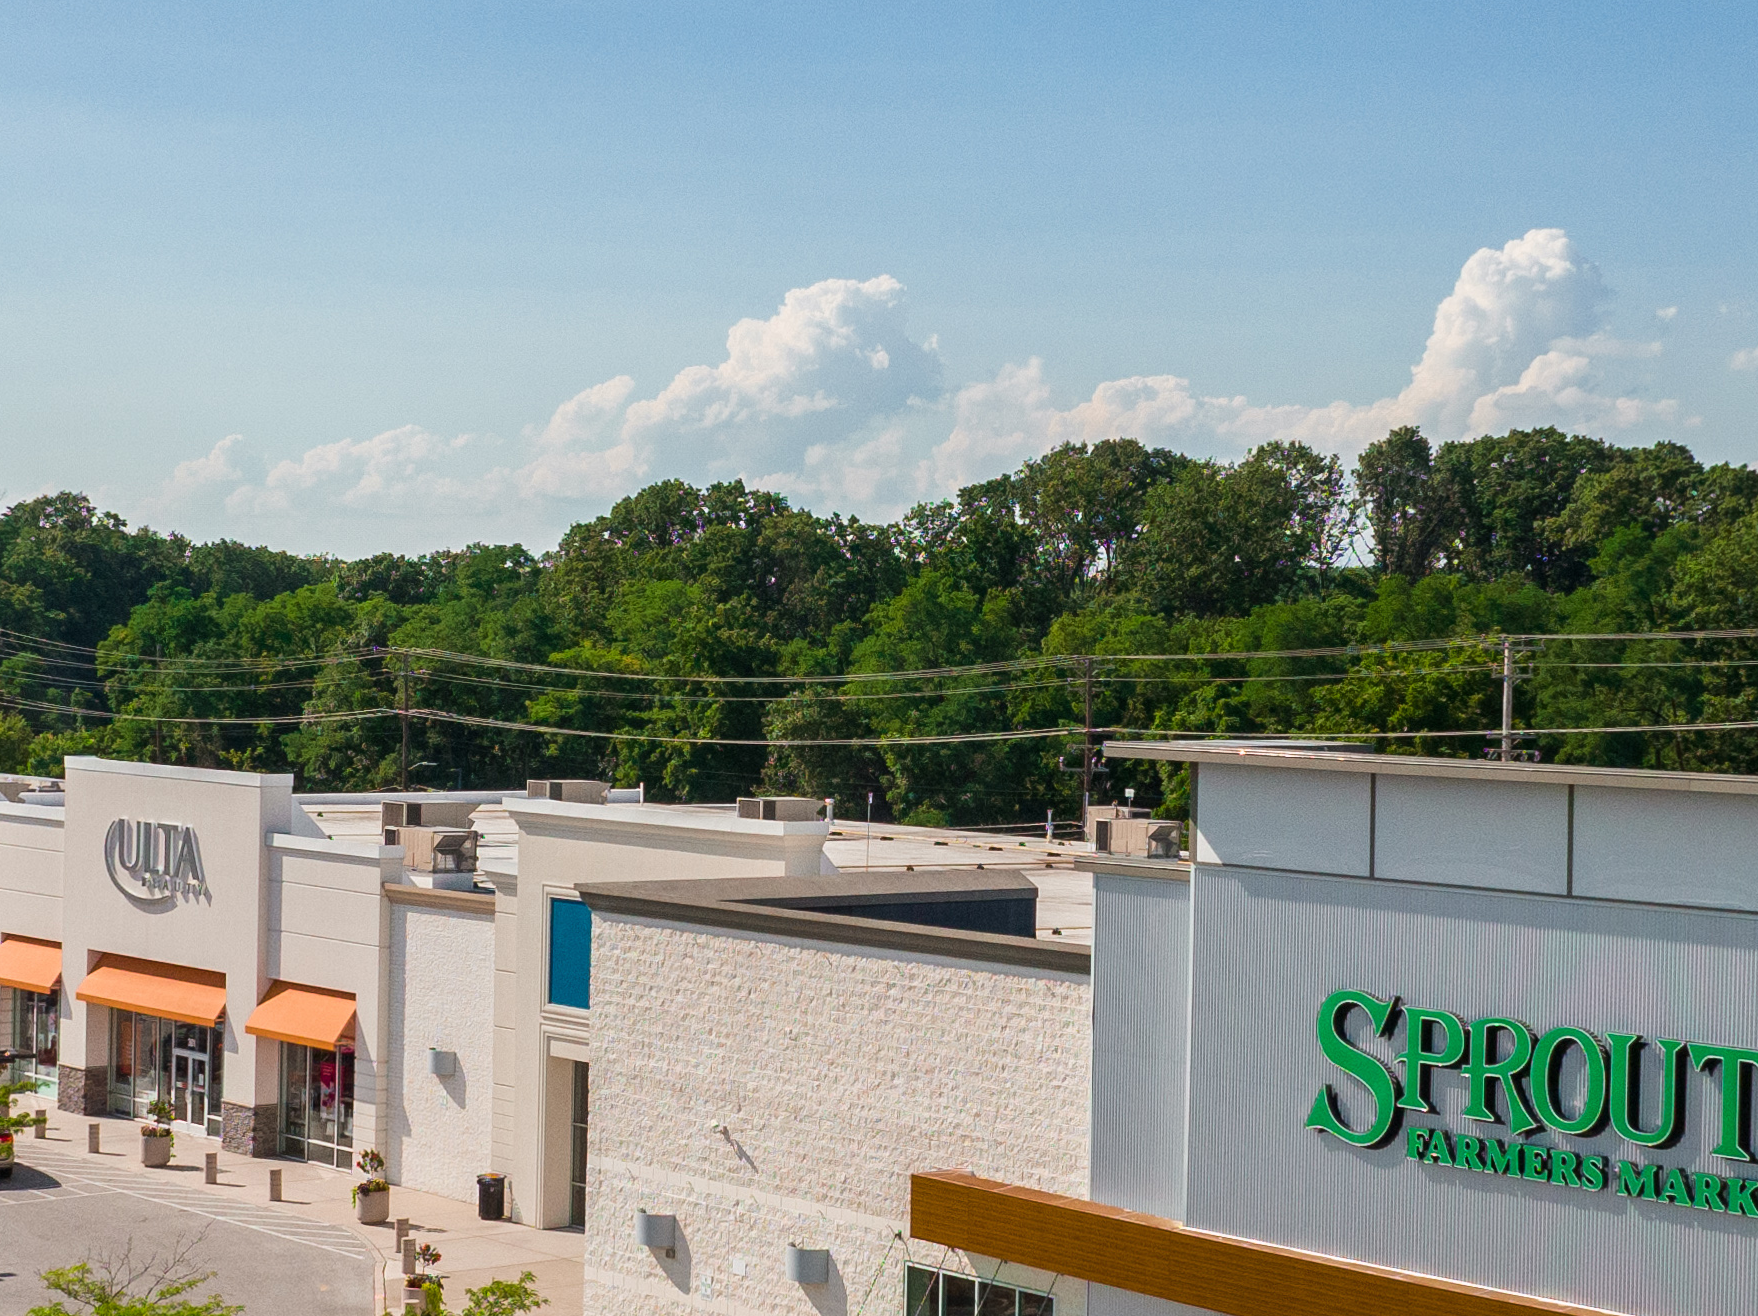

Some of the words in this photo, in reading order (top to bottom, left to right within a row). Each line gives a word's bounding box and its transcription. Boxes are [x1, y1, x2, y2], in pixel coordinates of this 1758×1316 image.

[117, 818, 201, 881] ULTA
[141, 874, 204, 897] BEAUTY
[1405, 1126, 1607, 1192] FARMERS
